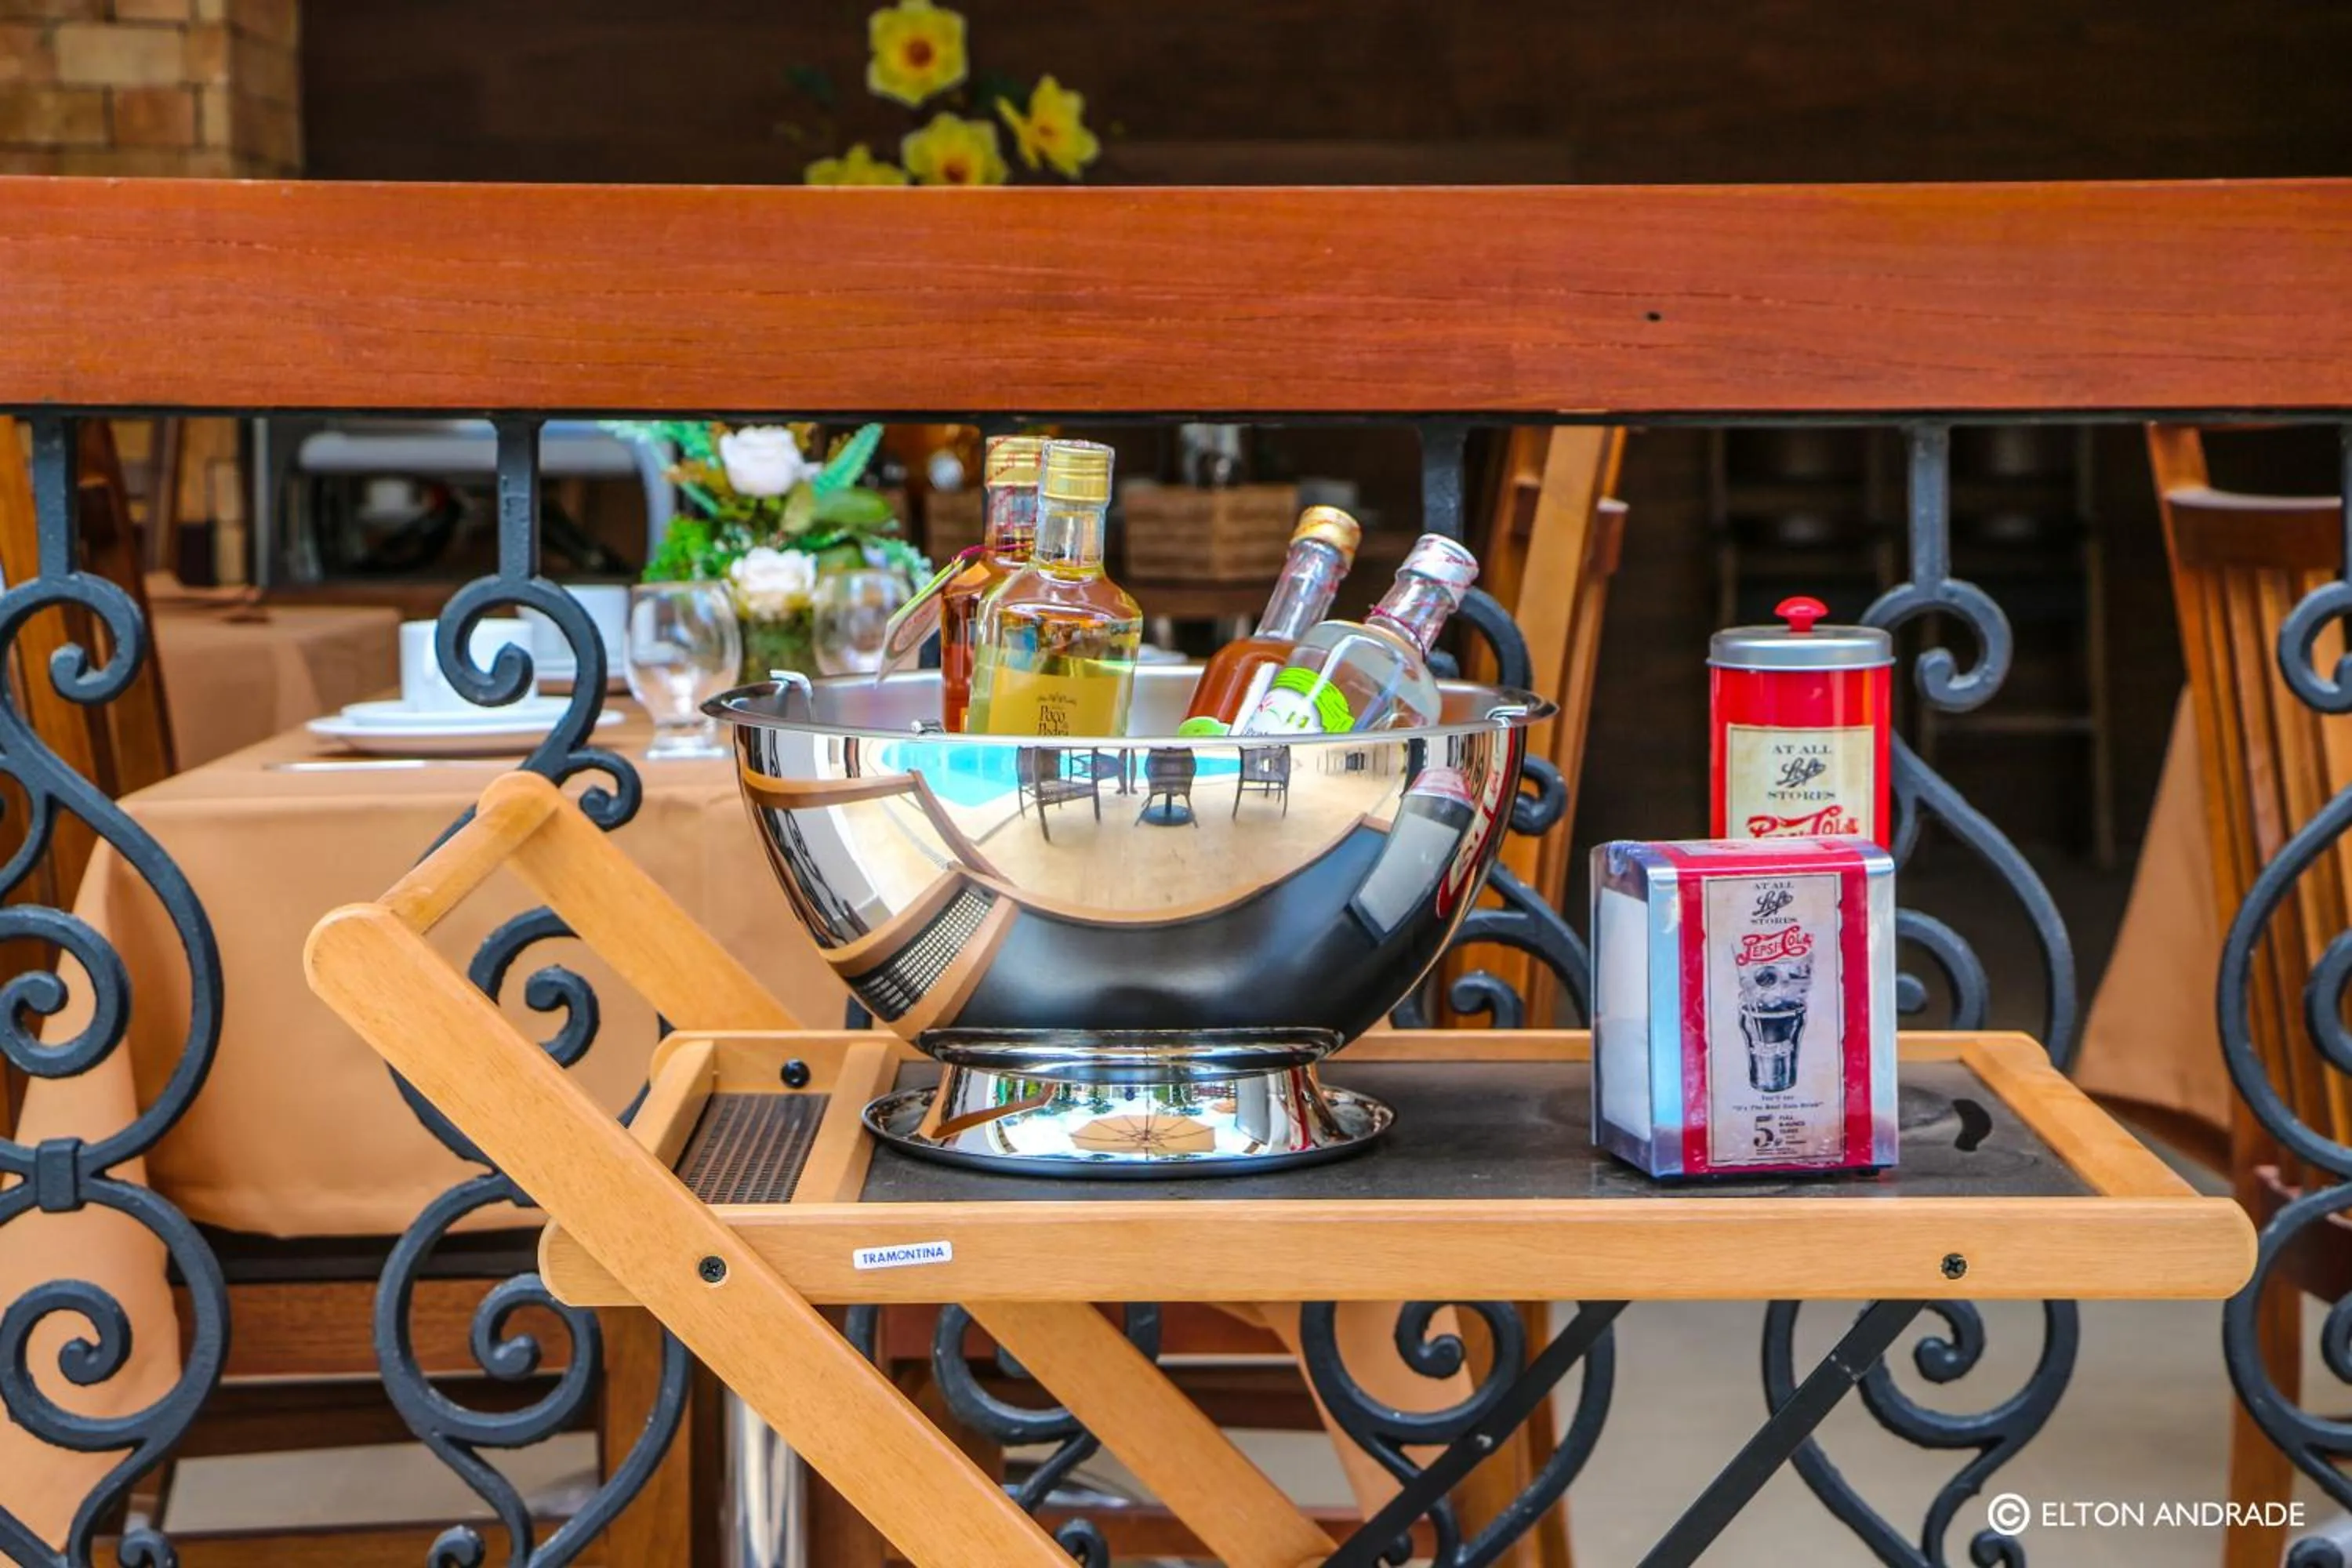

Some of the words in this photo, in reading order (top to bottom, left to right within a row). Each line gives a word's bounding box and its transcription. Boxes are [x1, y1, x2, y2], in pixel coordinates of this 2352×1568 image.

[1773, 744, 1794, 754] AT
[1800, 744, 1832, 754] ALL
[1767, 790, 1835, 800] STORES
[1754, 882, 1769, 891] AT
[1773, 880, 1794, 889] ALL
[1751, 916, 1798, 925] STORES
[862, 1247, 945, 1265] TRAMONTINA
